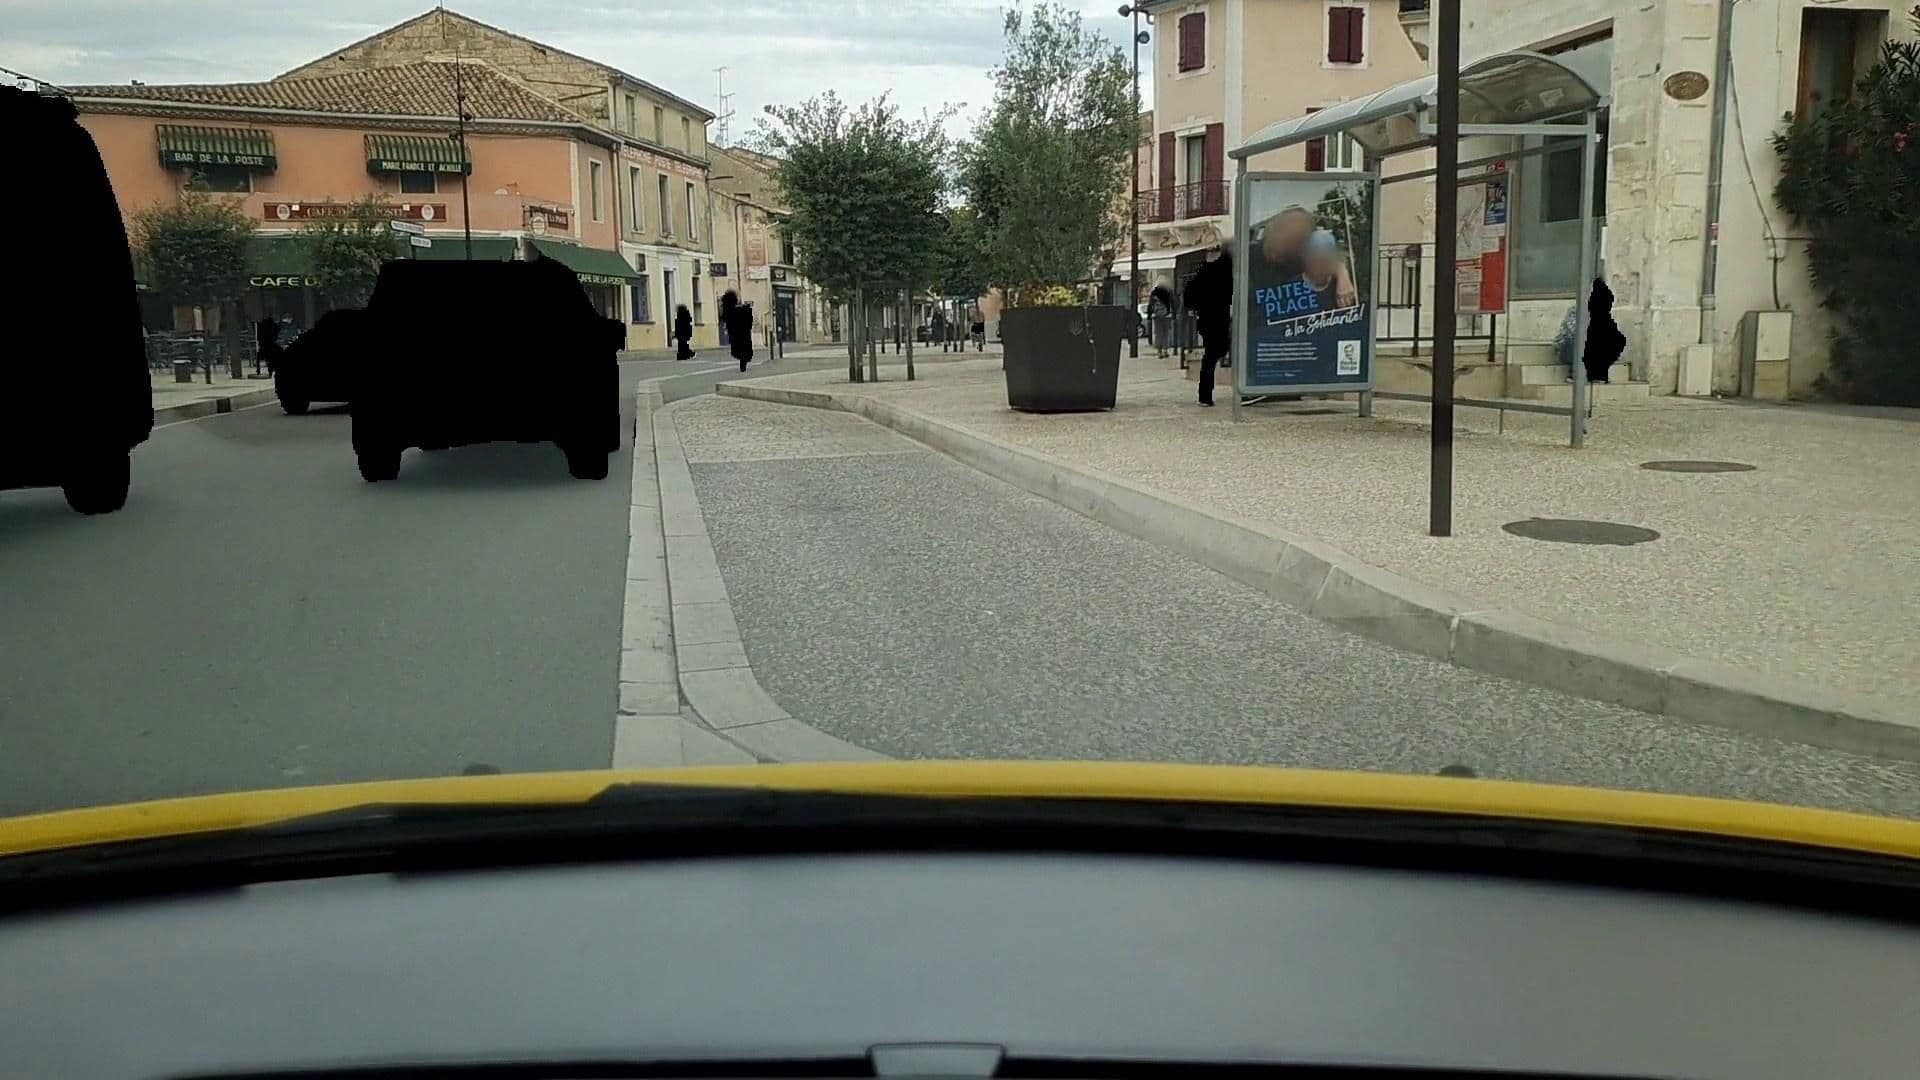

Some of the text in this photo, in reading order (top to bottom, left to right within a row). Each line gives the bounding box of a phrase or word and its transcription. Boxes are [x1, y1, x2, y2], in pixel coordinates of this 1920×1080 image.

[174, 152, 264, 166] BAR DE LA POSTE
[249, 276, 299, 287] CAFE
[1255, 280, 1313, 304] FAITES
[1265, 294, 1319, 318] PLACE
[1284, 324, 1293, 337] à
[1294, 319, 1304, 336] la
